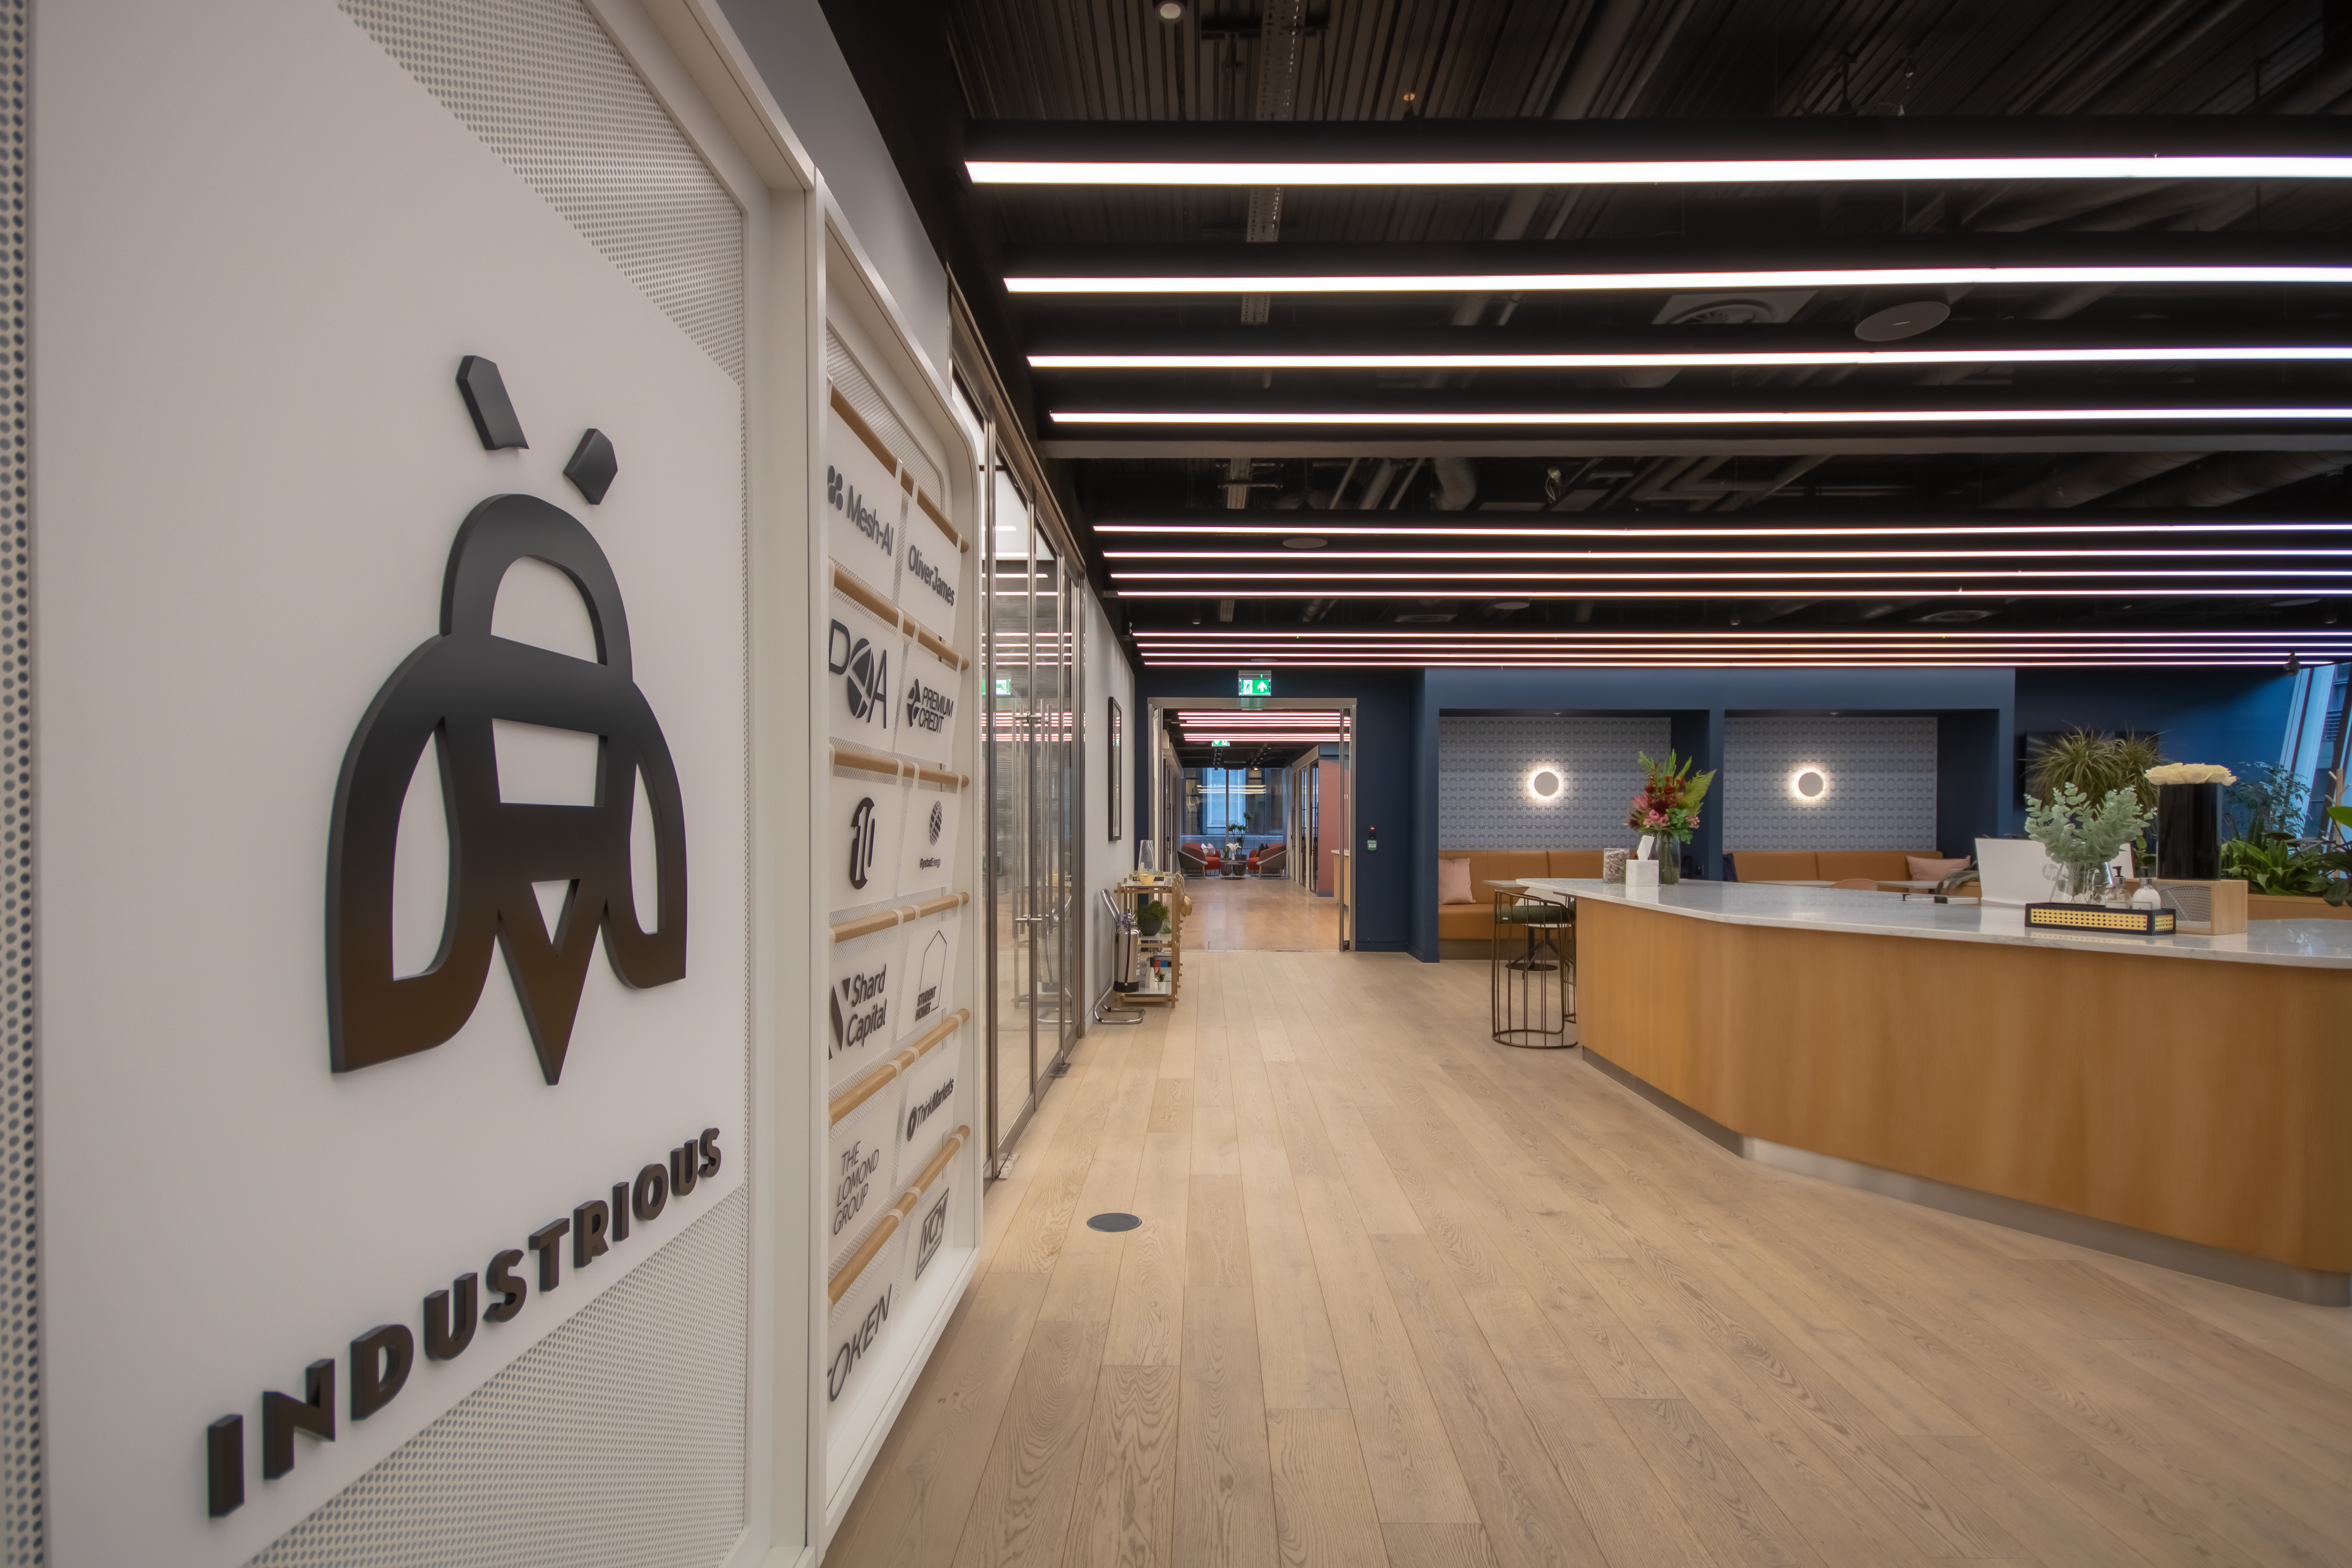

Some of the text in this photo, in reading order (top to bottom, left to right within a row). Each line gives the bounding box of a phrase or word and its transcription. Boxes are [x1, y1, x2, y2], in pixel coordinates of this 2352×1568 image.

[847, 484, 894, 557] Mesh-AI
[919, 707, 945, 734] CREDIT
[922, 686, 954, 718] PREMIUM
[852, 963, 887, 1007] Shard
[847, 998, 887, 1048] Capital
[917, 1078, 954, 1128] ThinkMarkets
[837, 1148, 879, 1208] LOMOND
[842, 1140, 861, 1176] THE
[833, 1183, 869, 1235] GROUP
[207, 1127, 721, 1518] INDUSTRIOUS
